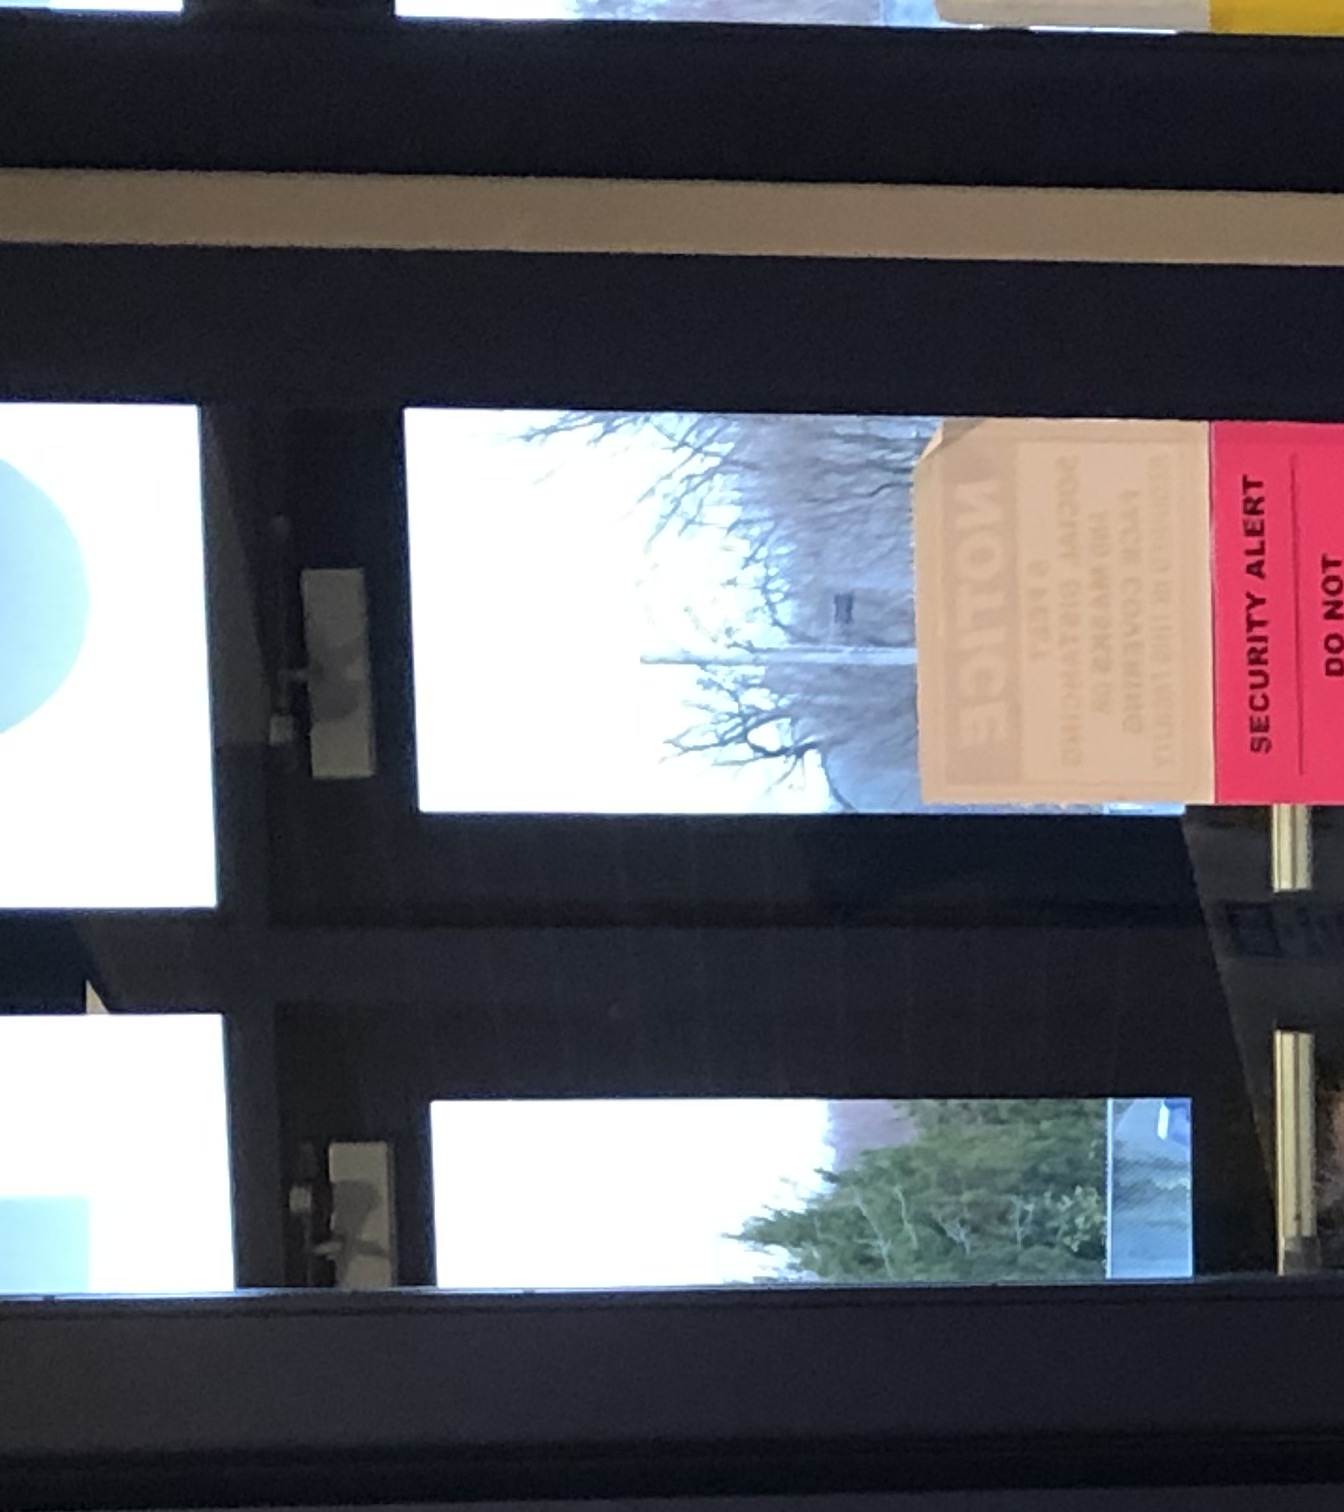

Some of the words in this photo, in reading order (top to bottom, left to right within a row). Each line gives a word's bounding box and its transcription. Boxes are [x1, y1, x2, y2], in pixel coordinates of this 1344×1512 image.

[1242, 475, 1266, 580] ALERT
[1321, 554, 1344, 621] NOT
[1245, 592, 1271, 754] SECURITY
[1324, 633, 1344, 678] DO
